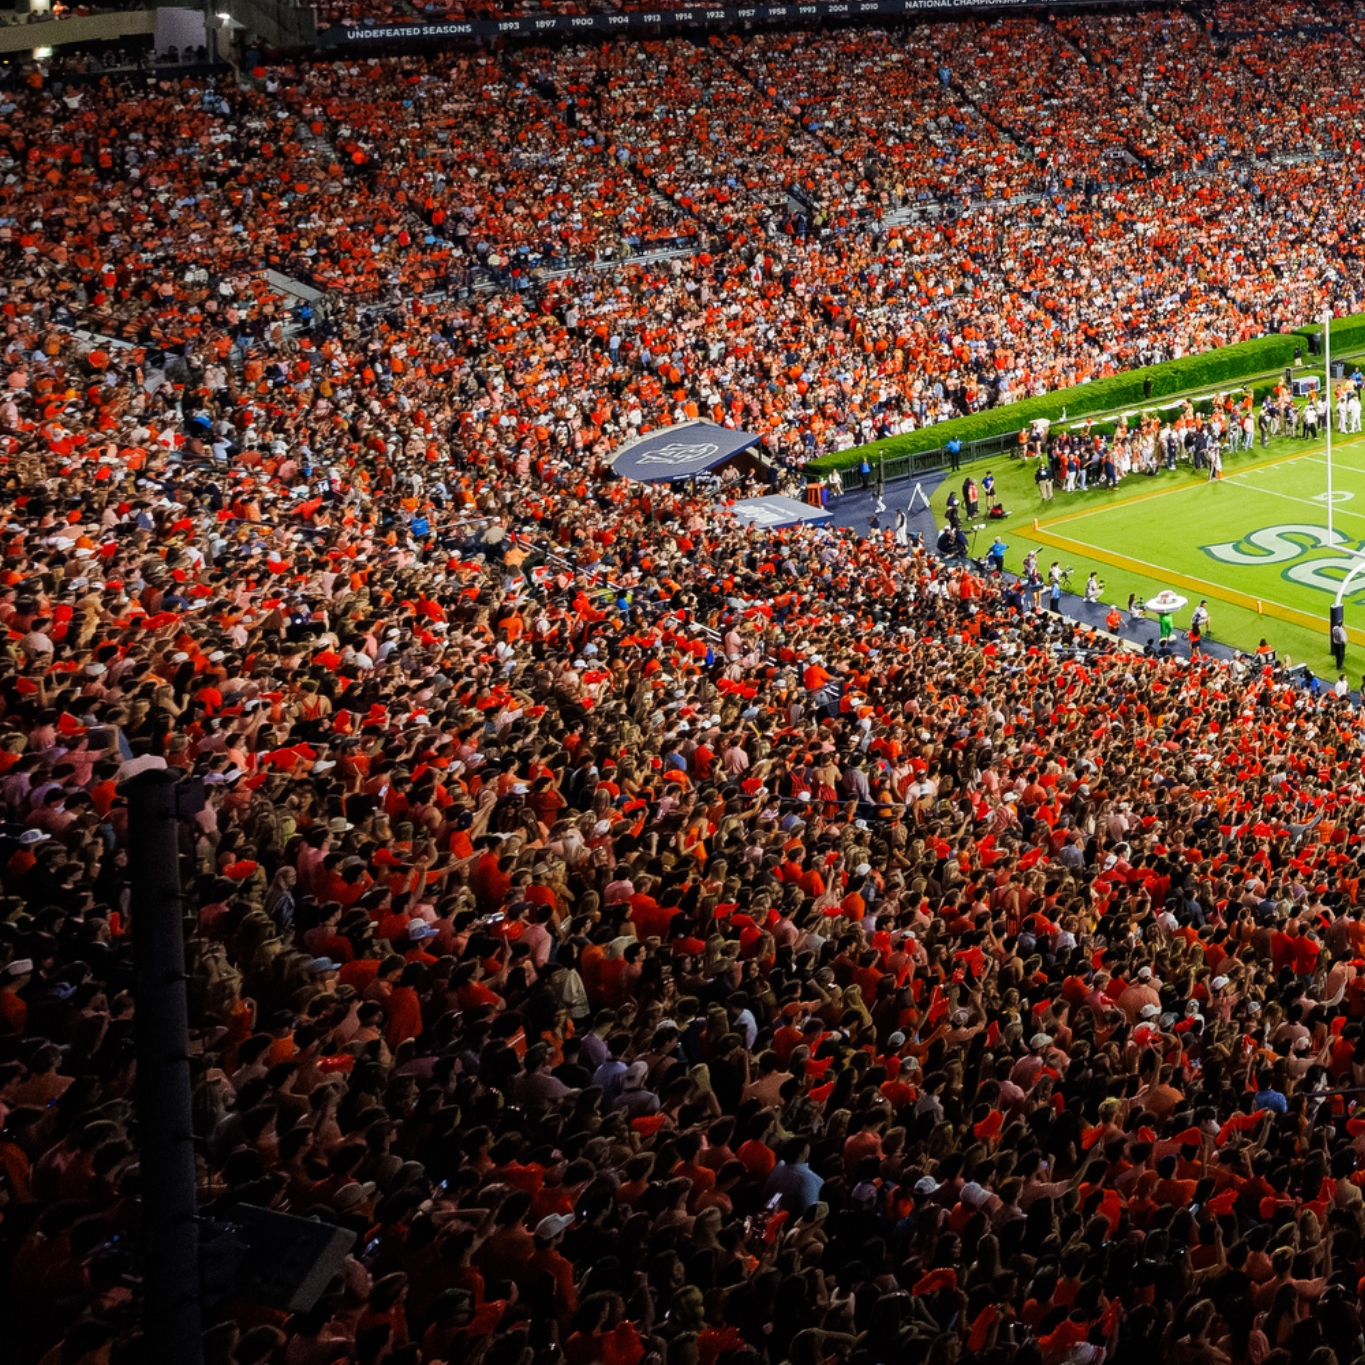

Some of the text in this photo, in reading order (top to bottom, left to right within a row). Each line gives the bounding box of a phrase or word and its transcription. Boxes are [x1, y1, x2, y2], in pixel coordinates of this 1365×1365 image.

[905, 0, 952, 9] NATIONAL
[347, 27, 420, 40] UNDEFEATED
[422, 24, 472, 36] SEASONS
[498, 22, 520, 30] 1893
[535, 20, 556, 29] 1897
[571, 18, 594, 26] 1900
[608, 16, 629, 24] 1904
[643, 14, 661, 22] 1913
[706, 11, 725, 19] 1932
[738, 9, 756, 17] 1957
[768, 7, 787, 15] 1958
[799, 6, 816, 14] 1993
[828, 4, 848, 12] 2004
[860, 3, 879, 11] 2010
